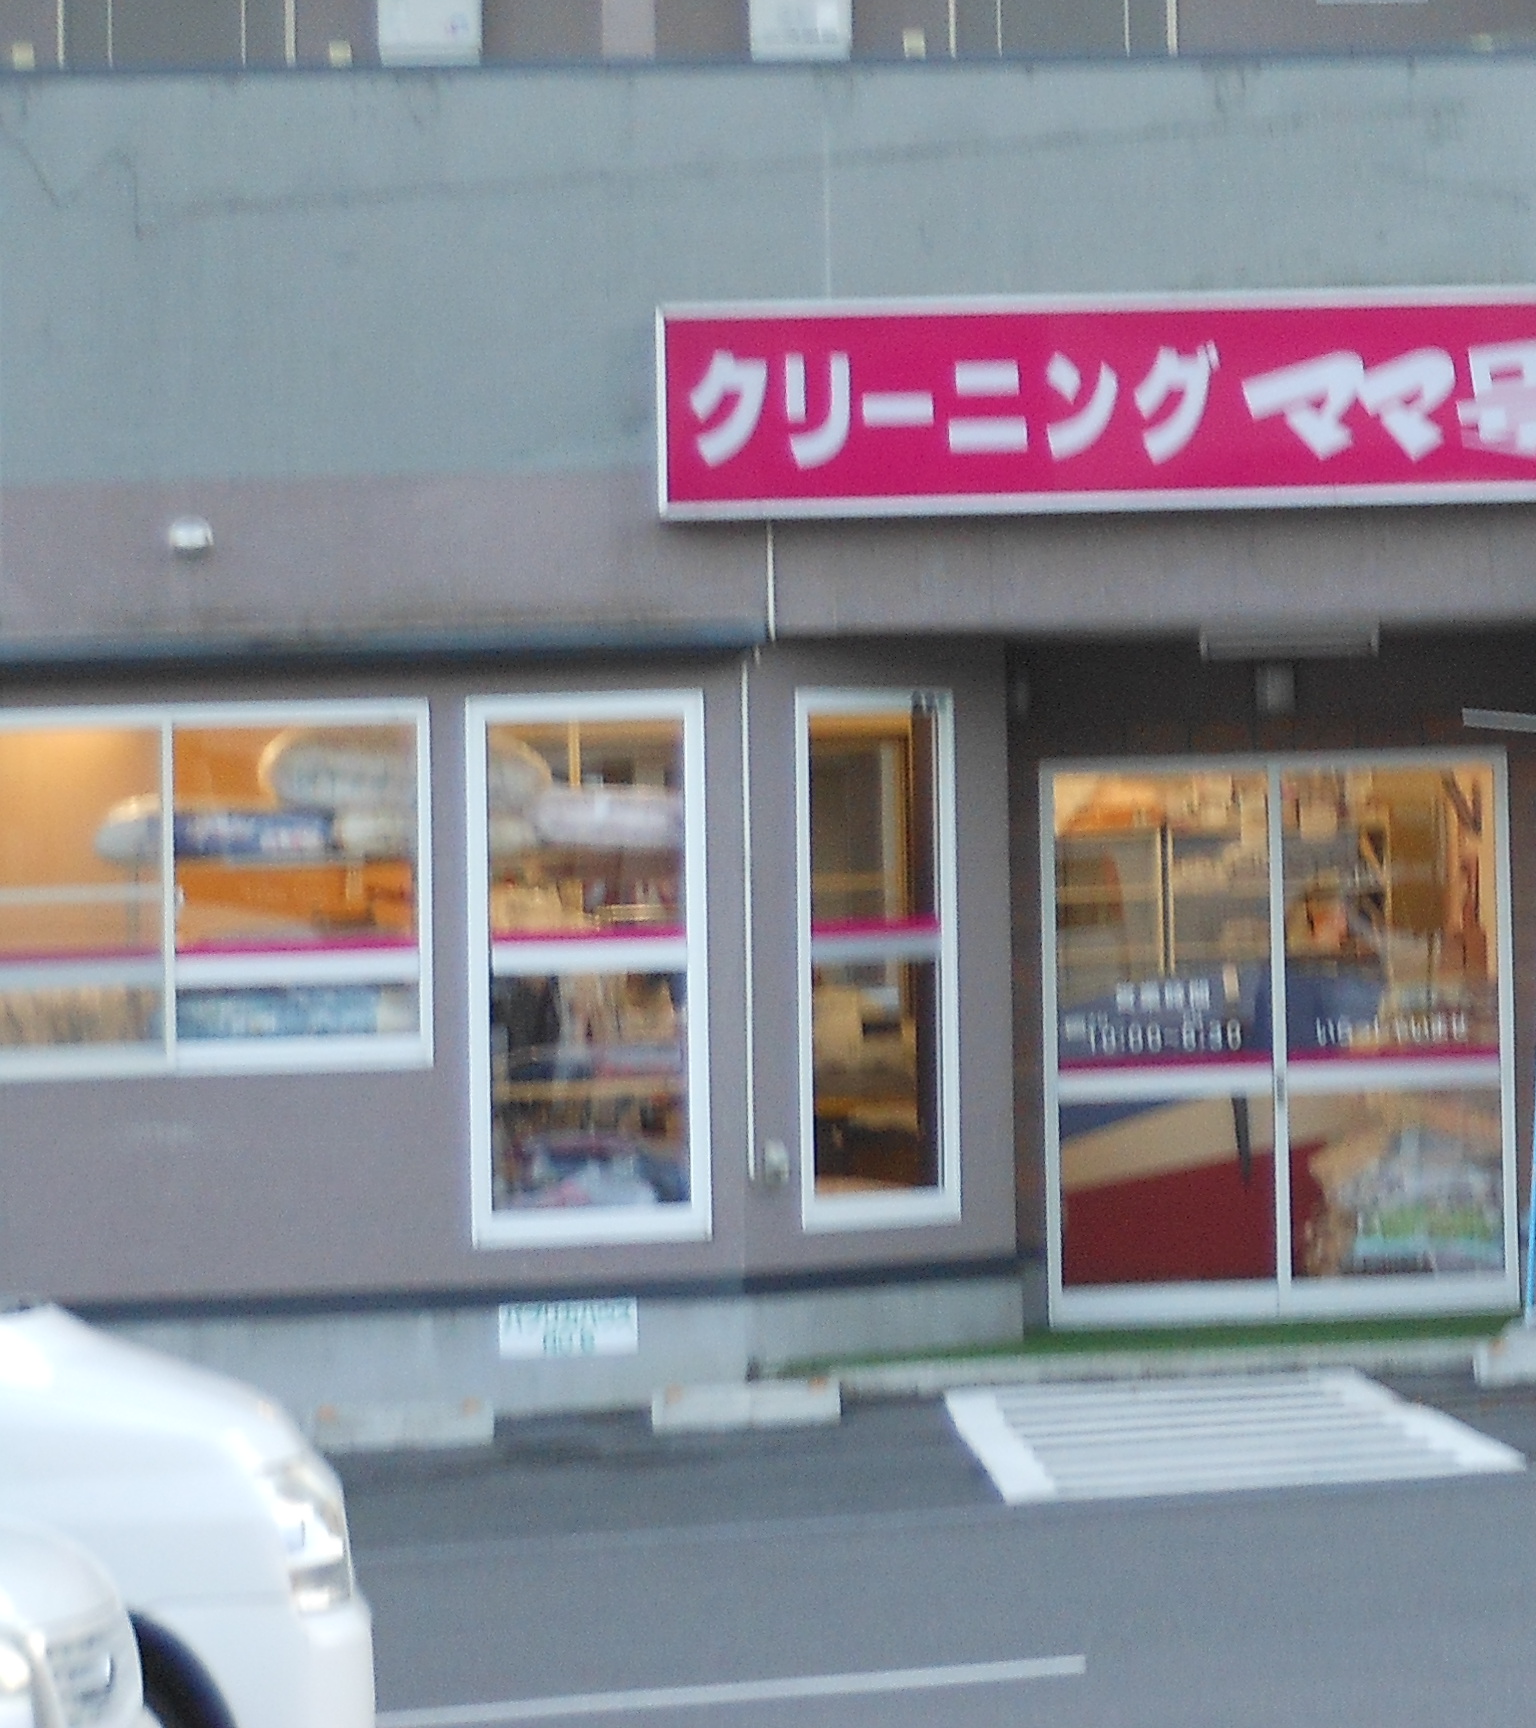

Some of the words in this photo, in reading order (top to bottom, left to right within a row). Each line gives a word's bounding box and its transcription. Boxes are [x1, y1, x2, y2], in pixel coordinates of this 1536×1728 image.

[689, 340, 1219, 469] クリーニング
